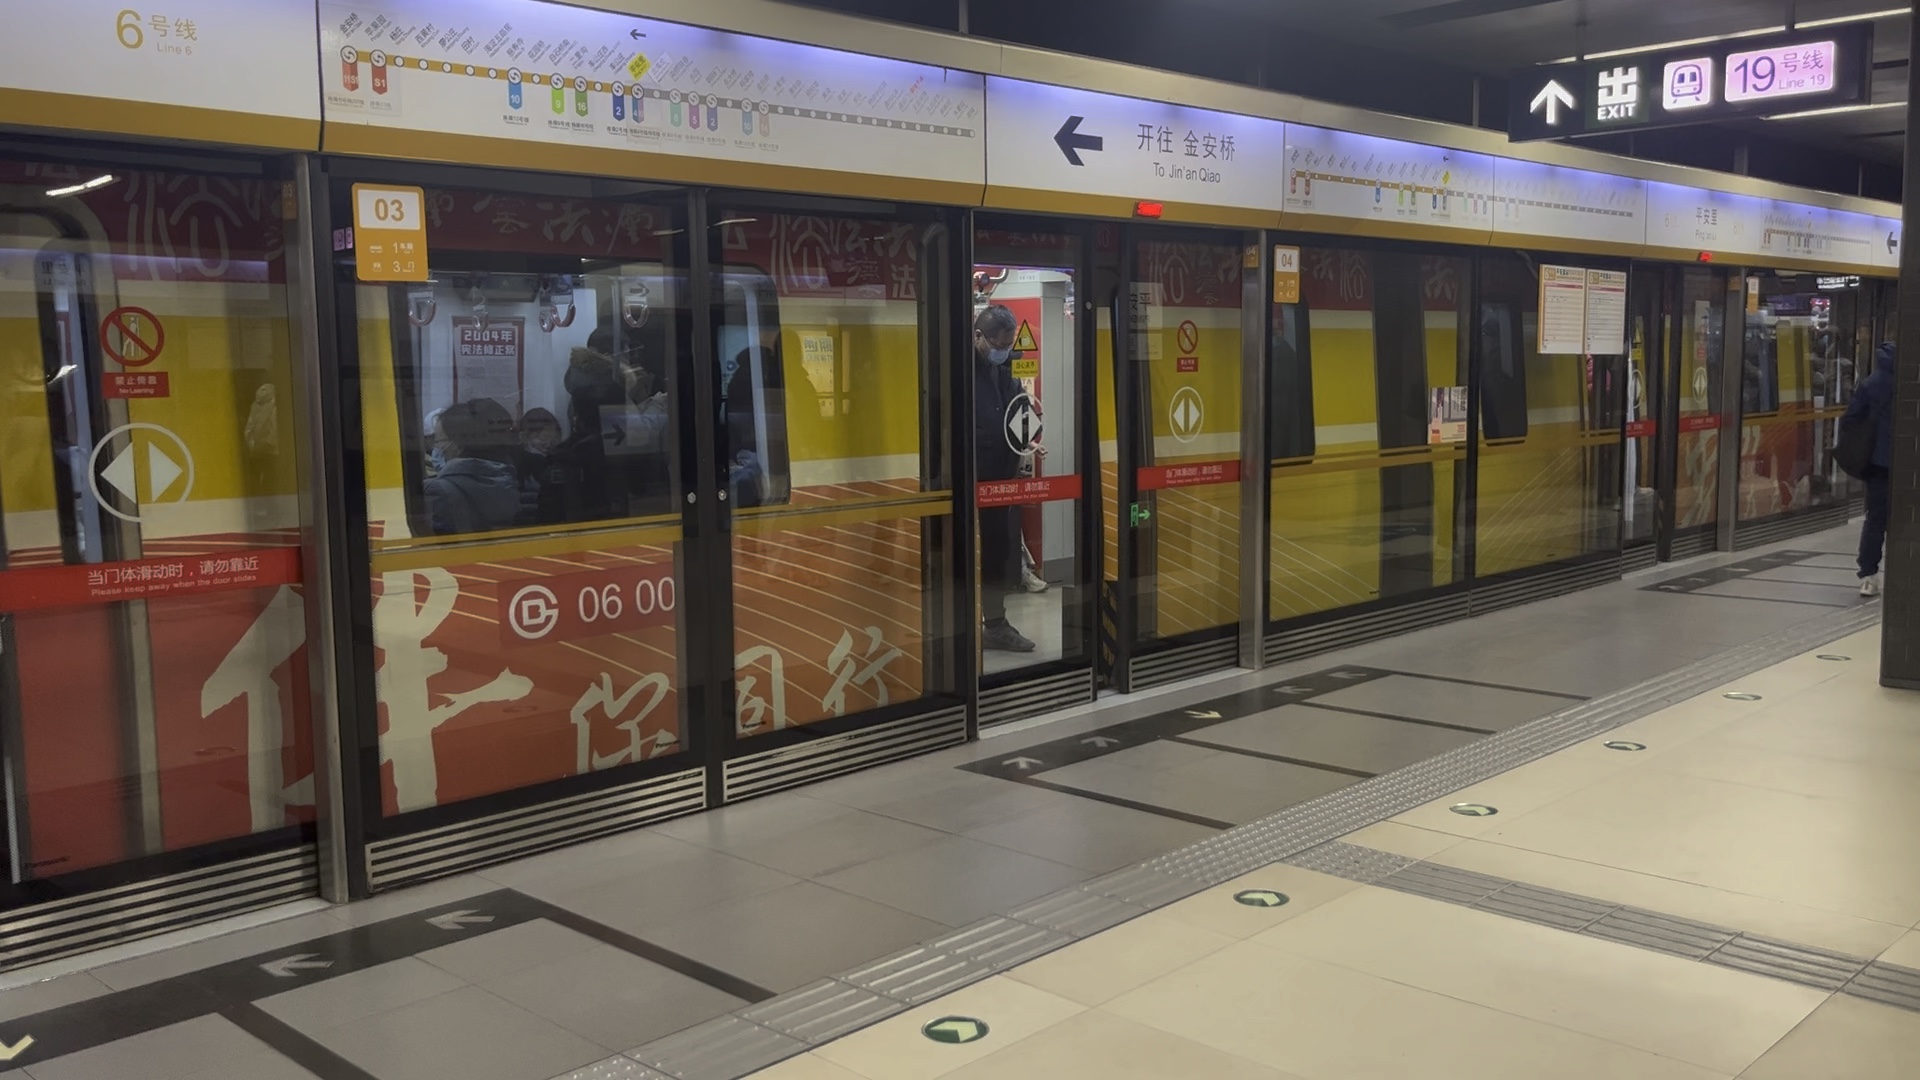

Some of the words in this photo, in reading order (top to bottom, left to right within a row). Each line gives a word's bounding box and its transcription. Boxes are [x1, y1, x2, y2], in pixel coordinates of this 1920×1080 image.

[115, 10, 143, 49] 6
[149, 17, 198, 42] 号线
[157, 42, 186, 55] Line
[186, 45, 192, 56] 6
[1780, 50, 1824, 73] 号线
[1734, 56, 1775, 93] 19
[374, 78, 386, 87] S1
[1779, 78, 1804, 90] Line
[1809, 74, 1825, 87] 19
[510, 94, 520, 104] 10
[555, 99, 561, 109] 9
[576, 102, 587, 111] 16
[616, 106, 621, 116] 2
[1597, 104, 1635, 121] EXIT
[692, 116, 697, 124] 5
[710, 118, 716, 126] 2
[1137, 124, 1174, 154] 开往
[1183, 130, 1235, 161] 金安桥
[1153, 162, 1165, 178] To
[1169, 164, 1198, 180] Jin'an
[1199, 168, 1221, 184] Qiao
[375, 198, 404, 222] 03
[1281, 253, 1293, 268] 04
[464, 330, 513, 342] 2004年
[461, 344, 516, 356] 宪法修正案
[91, 588, 122, 597] Please
[578, 584, 623, 622] 06
[636, 576, 675, 614] 00
